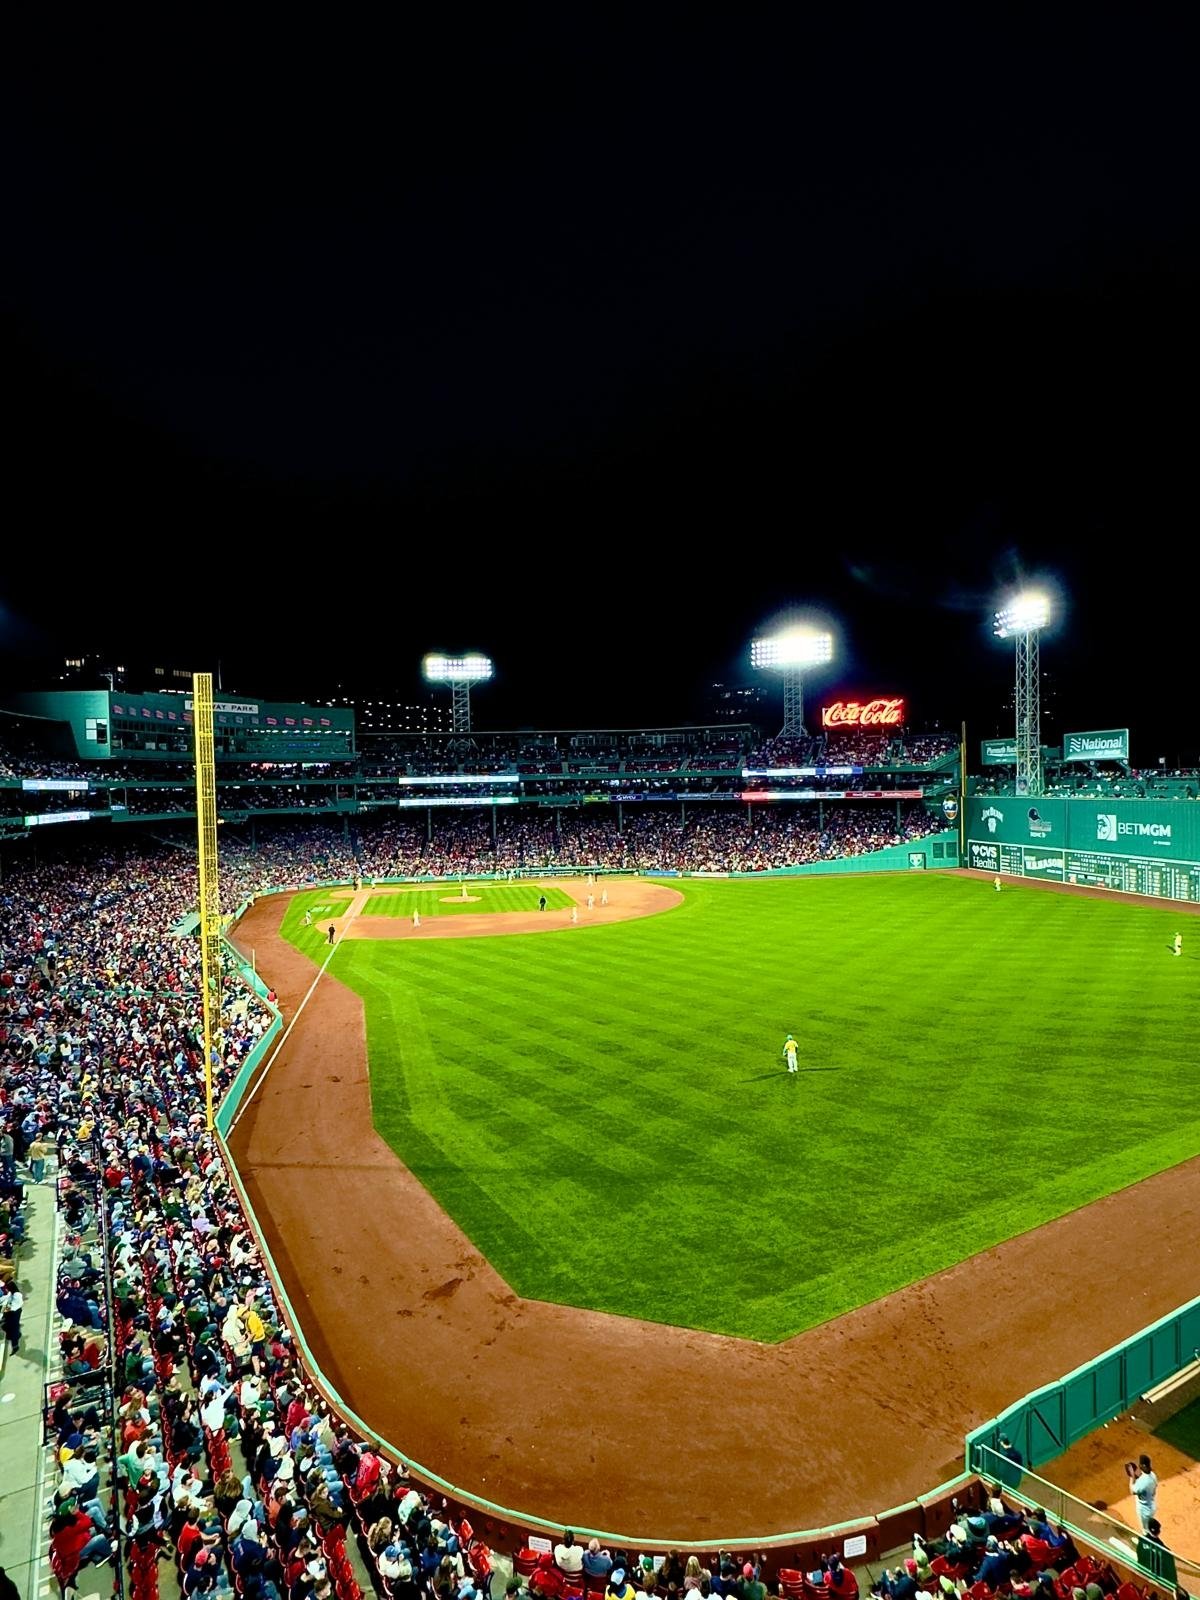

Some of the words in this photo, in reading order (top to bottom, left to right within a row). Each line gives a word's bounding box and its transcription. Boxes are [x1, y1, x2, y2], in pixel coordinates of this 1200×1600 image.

[231, 704, 254, 712] PARK
[824, 699, 904, 727] Coca-Cola
[1081, 735, 1123, 751] National
[1118, 822, 1171, 837] BETMGM
[979, 845, 997, 858] CVS
[973, 856, 997, 870] Health
